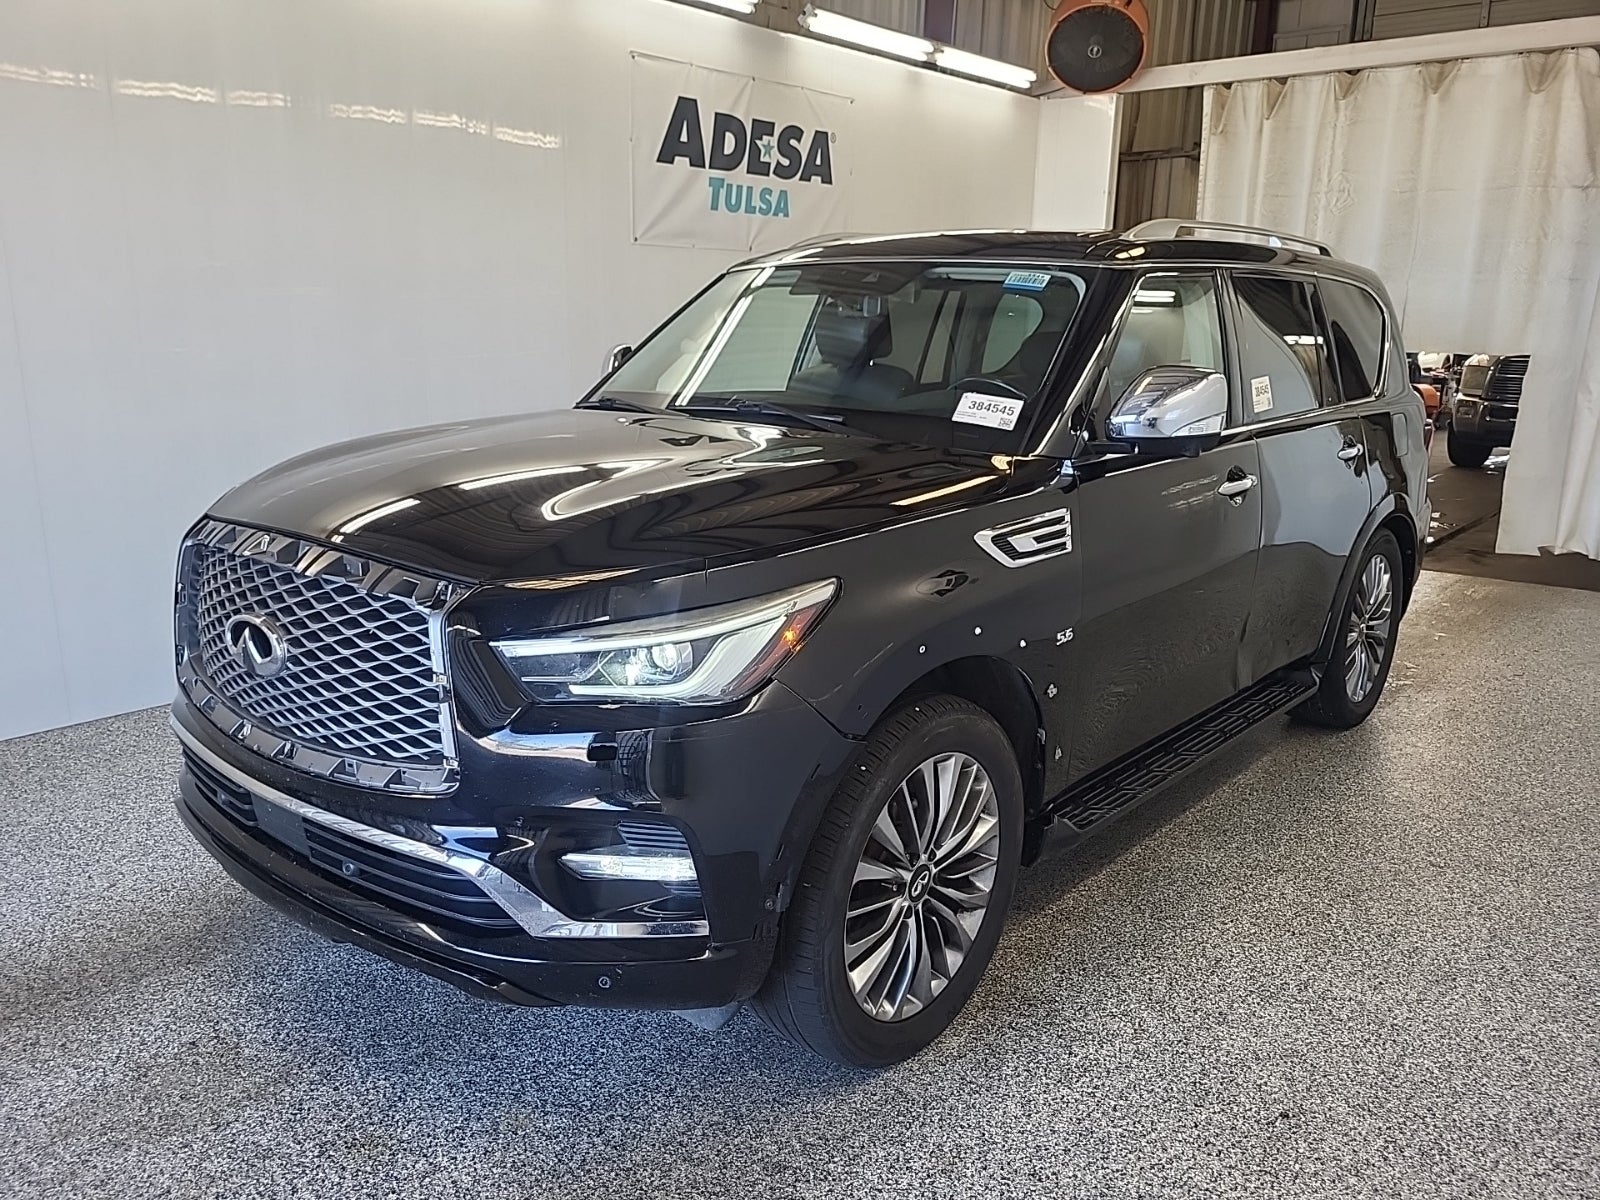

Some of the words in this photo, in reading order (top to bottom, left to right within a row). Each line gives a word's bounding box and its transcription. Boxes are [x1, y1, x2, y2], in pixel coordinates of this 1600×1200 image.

[656, 96, 833, 186] ADESA
[708, 176, 790, 218] TULSA
[968, 400, 1016, 416] 384545
